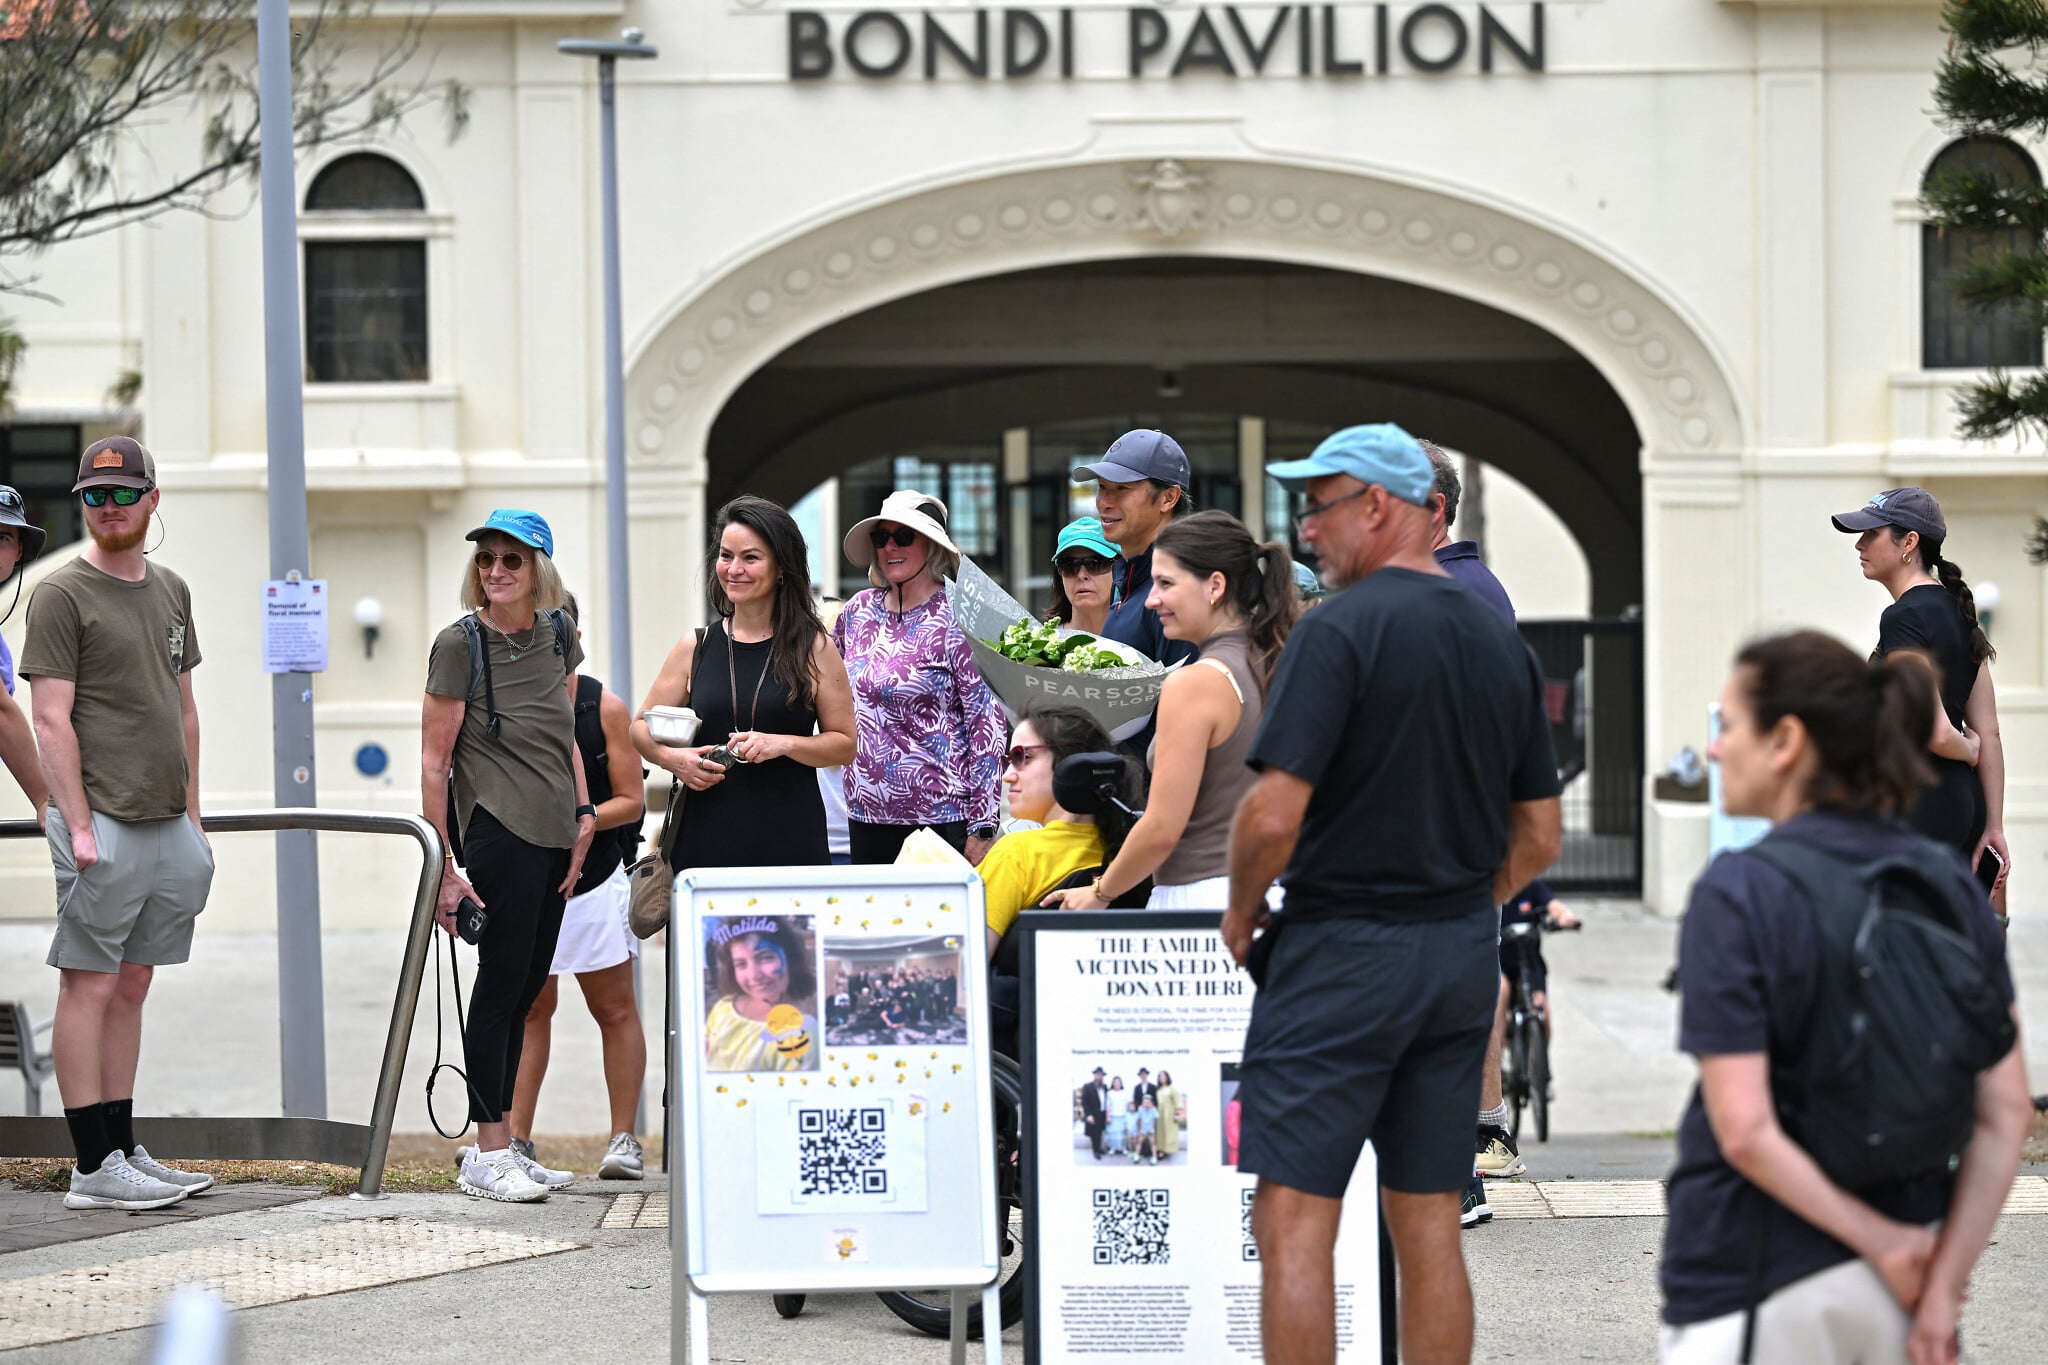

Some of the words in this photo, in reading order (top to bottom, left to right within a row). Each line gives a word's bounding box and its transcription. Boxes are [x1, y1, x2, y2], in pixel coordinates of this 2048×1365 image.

[789, 7, 1073, 81] BONDI
[1129, 2, 1544, 78] PAVILION
[959, 578, 976, 628] ONS
[968, 591, 985, 633] RIST
[1025, 674, 1163, 700] PEARSON
[1108, 692, 1160, 708] FLOR
[712, 916, 779, 945] Matilda
[1096, 937, 1138, 954] THE
[1142, 937, 1228, 954] FAMILIE
[1076, 959, 1159, 975] VICTIMS
[1164, 959, 1217, 975] NEED
[1106, 980, 1191, 997] DONATE
[1196, 980, 1248, 997] HERE
